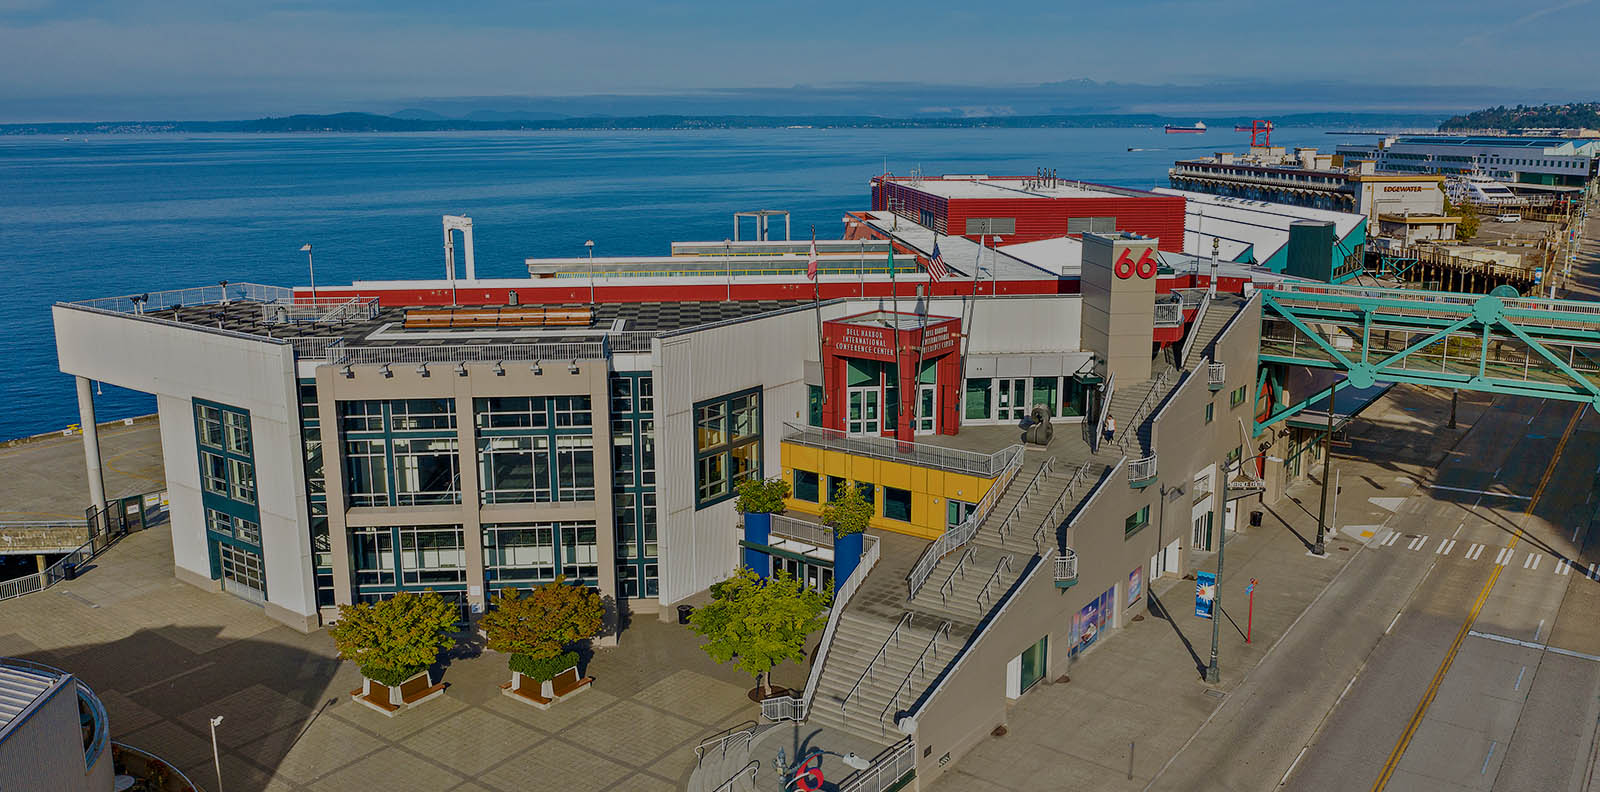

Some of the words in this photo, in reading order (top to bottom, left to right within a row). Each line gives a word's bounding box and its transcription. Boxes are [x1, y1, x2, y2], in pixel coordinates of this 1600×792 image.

[1114, 247, 1158, 280] 66
[846, 327, 859, 337] BELL
[861, 329, 883, 339] HARBOR
[842, 335, 886, 348] INTERNATIONAL
[835, 342, 873, 353] CONFERENCE
[873, 346, 894, 356] CENTER
